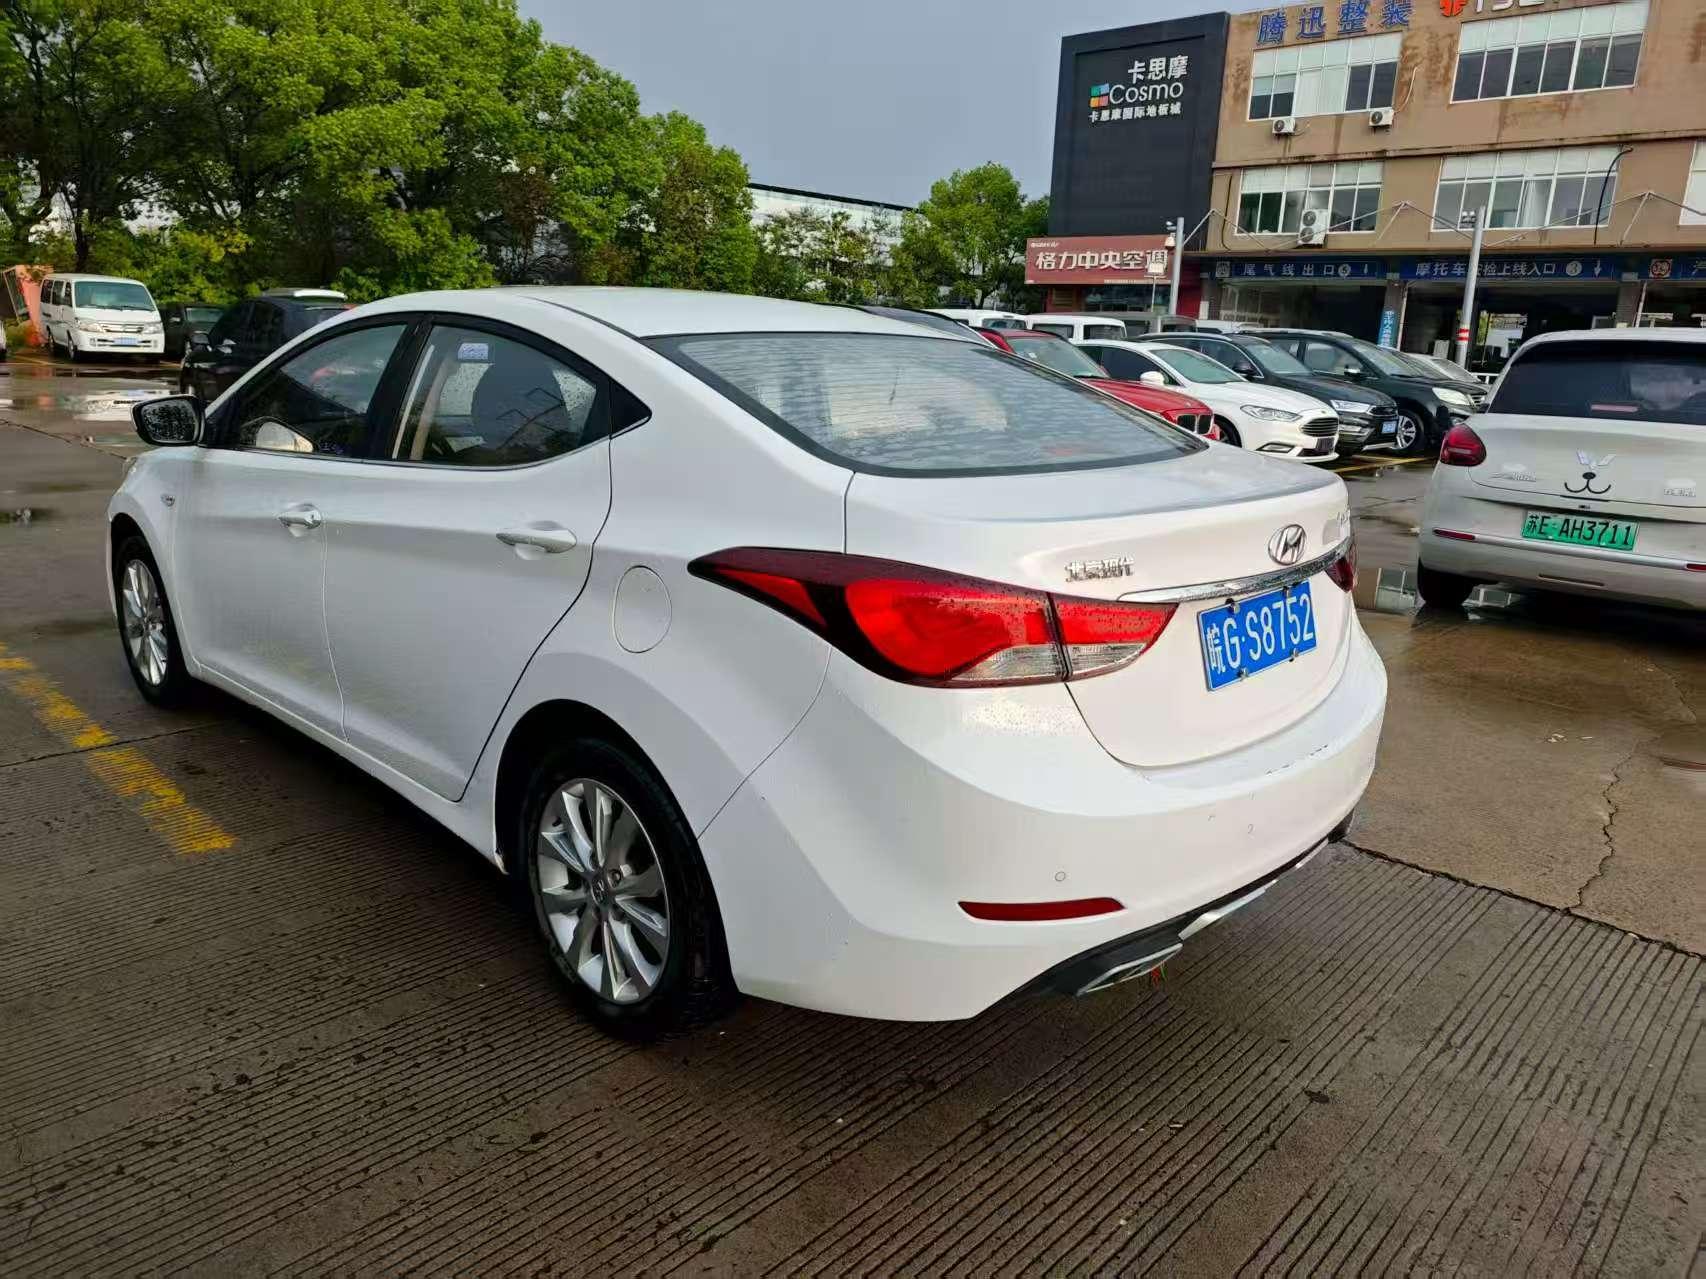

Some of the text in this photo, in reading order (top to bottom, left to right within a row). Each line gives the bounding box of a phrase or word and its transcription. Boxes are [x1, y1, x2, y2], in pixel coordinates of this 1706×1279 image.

[1127, 55, 1189, 84] 卡思摩
[1109, 82, 1184, 104] Cosmo
[1035, 250, 1169, 271] 格力中央空调
[1242, 263, 1336, 277] 尾气线出口
[1206, 593, 1314, 675] 皖G·S8752
